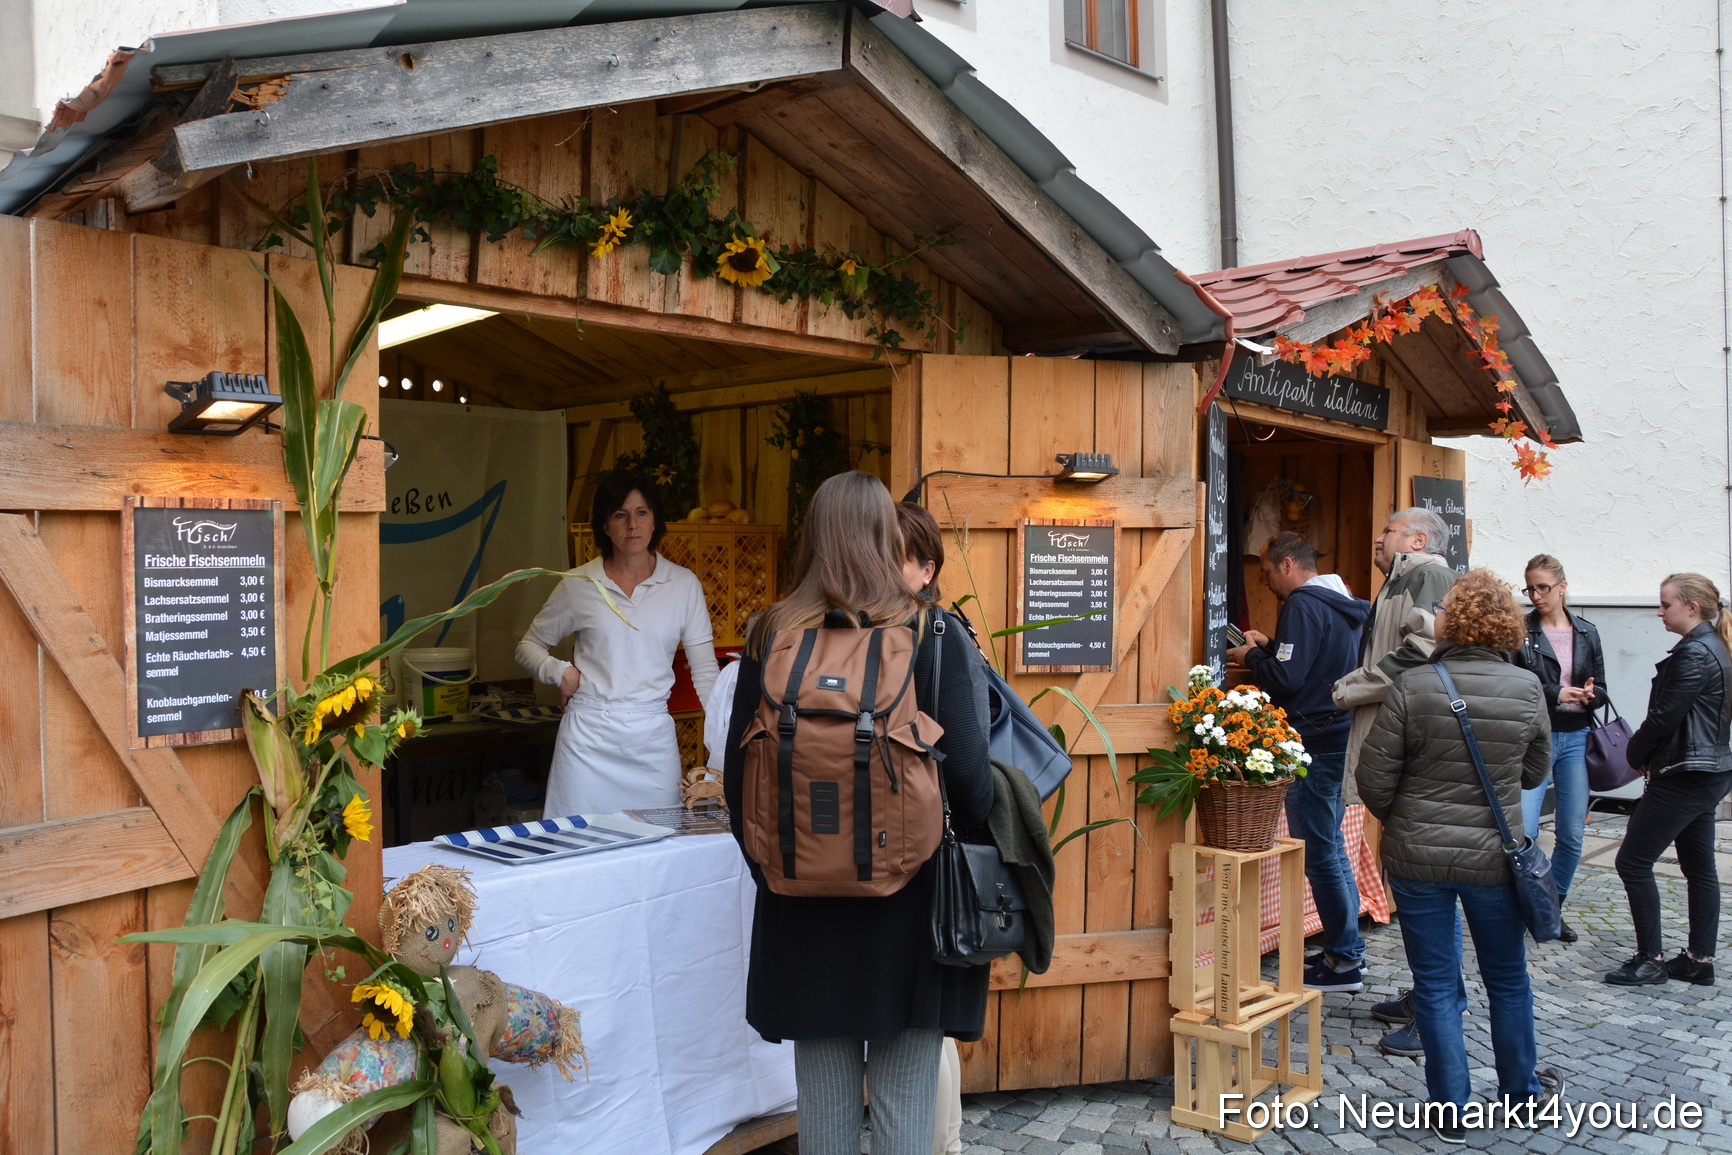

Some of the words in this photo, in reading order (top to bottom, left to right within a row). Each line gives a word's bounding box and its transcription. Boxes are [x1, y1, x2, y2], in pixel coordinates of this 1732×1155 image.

[1237, 355, 1315, 407] Antipasti
[1323, 378, 1379, 421] italiani
[390, 488, 453, 516] eßen
[144, 554, 186, 567] Frische
[189, 554, 266, 567] Fischsemmeln
[1030, 553, 1057, 563] Frische
[1058, 554, 1108, 564] Fischsemmeln
[144, 576, 219, 588] Bismarcksemmel
[240, 576, 258, 587] 3,00
[259, 576, 265, 586] €
[144, 594, 229, 606] Lachsersatzsemmel
[240, 593, 258, 604] 3,00
[260, 593, 265, 603] €
[1029, 590, 1083, 598] Bratheringssemmel
[1029, 601, 1069, 609] Matjessemmel
[1090, 601, 1103, 609] 3,50
[145, 611, 228, 624] Bratheringssemmel
[240, 610, 258, 621] 3,00
[260, 610, 265, 620] €
[145, 629, 208, 643] Matjessemmel
[241, 627, 259, 638] 3,50
[260, 627, 265, 636] €
[1028, 642, 1083, 650] Knoblauchgarnelen-
[146, 652, 171, 664] Echte
[173, 649, 234, 663] Räucherlachs-
[241, 647, 259, 658] 4,50
[260, 647, 266, 657] €
[146, 666, 179, 678] semmel
[147, 692, 232, 709] Knoblauchgarnelen-
[262, 689, 267, 698] €
[147, 711, 182, 723] semmel
[1221, 863, 1232, 890] Wein
[1221, 893, 1229, 912] aus
[1221, 915, 1231, 970] deutschen
[1220, 972, 1231, 1013] Landen
